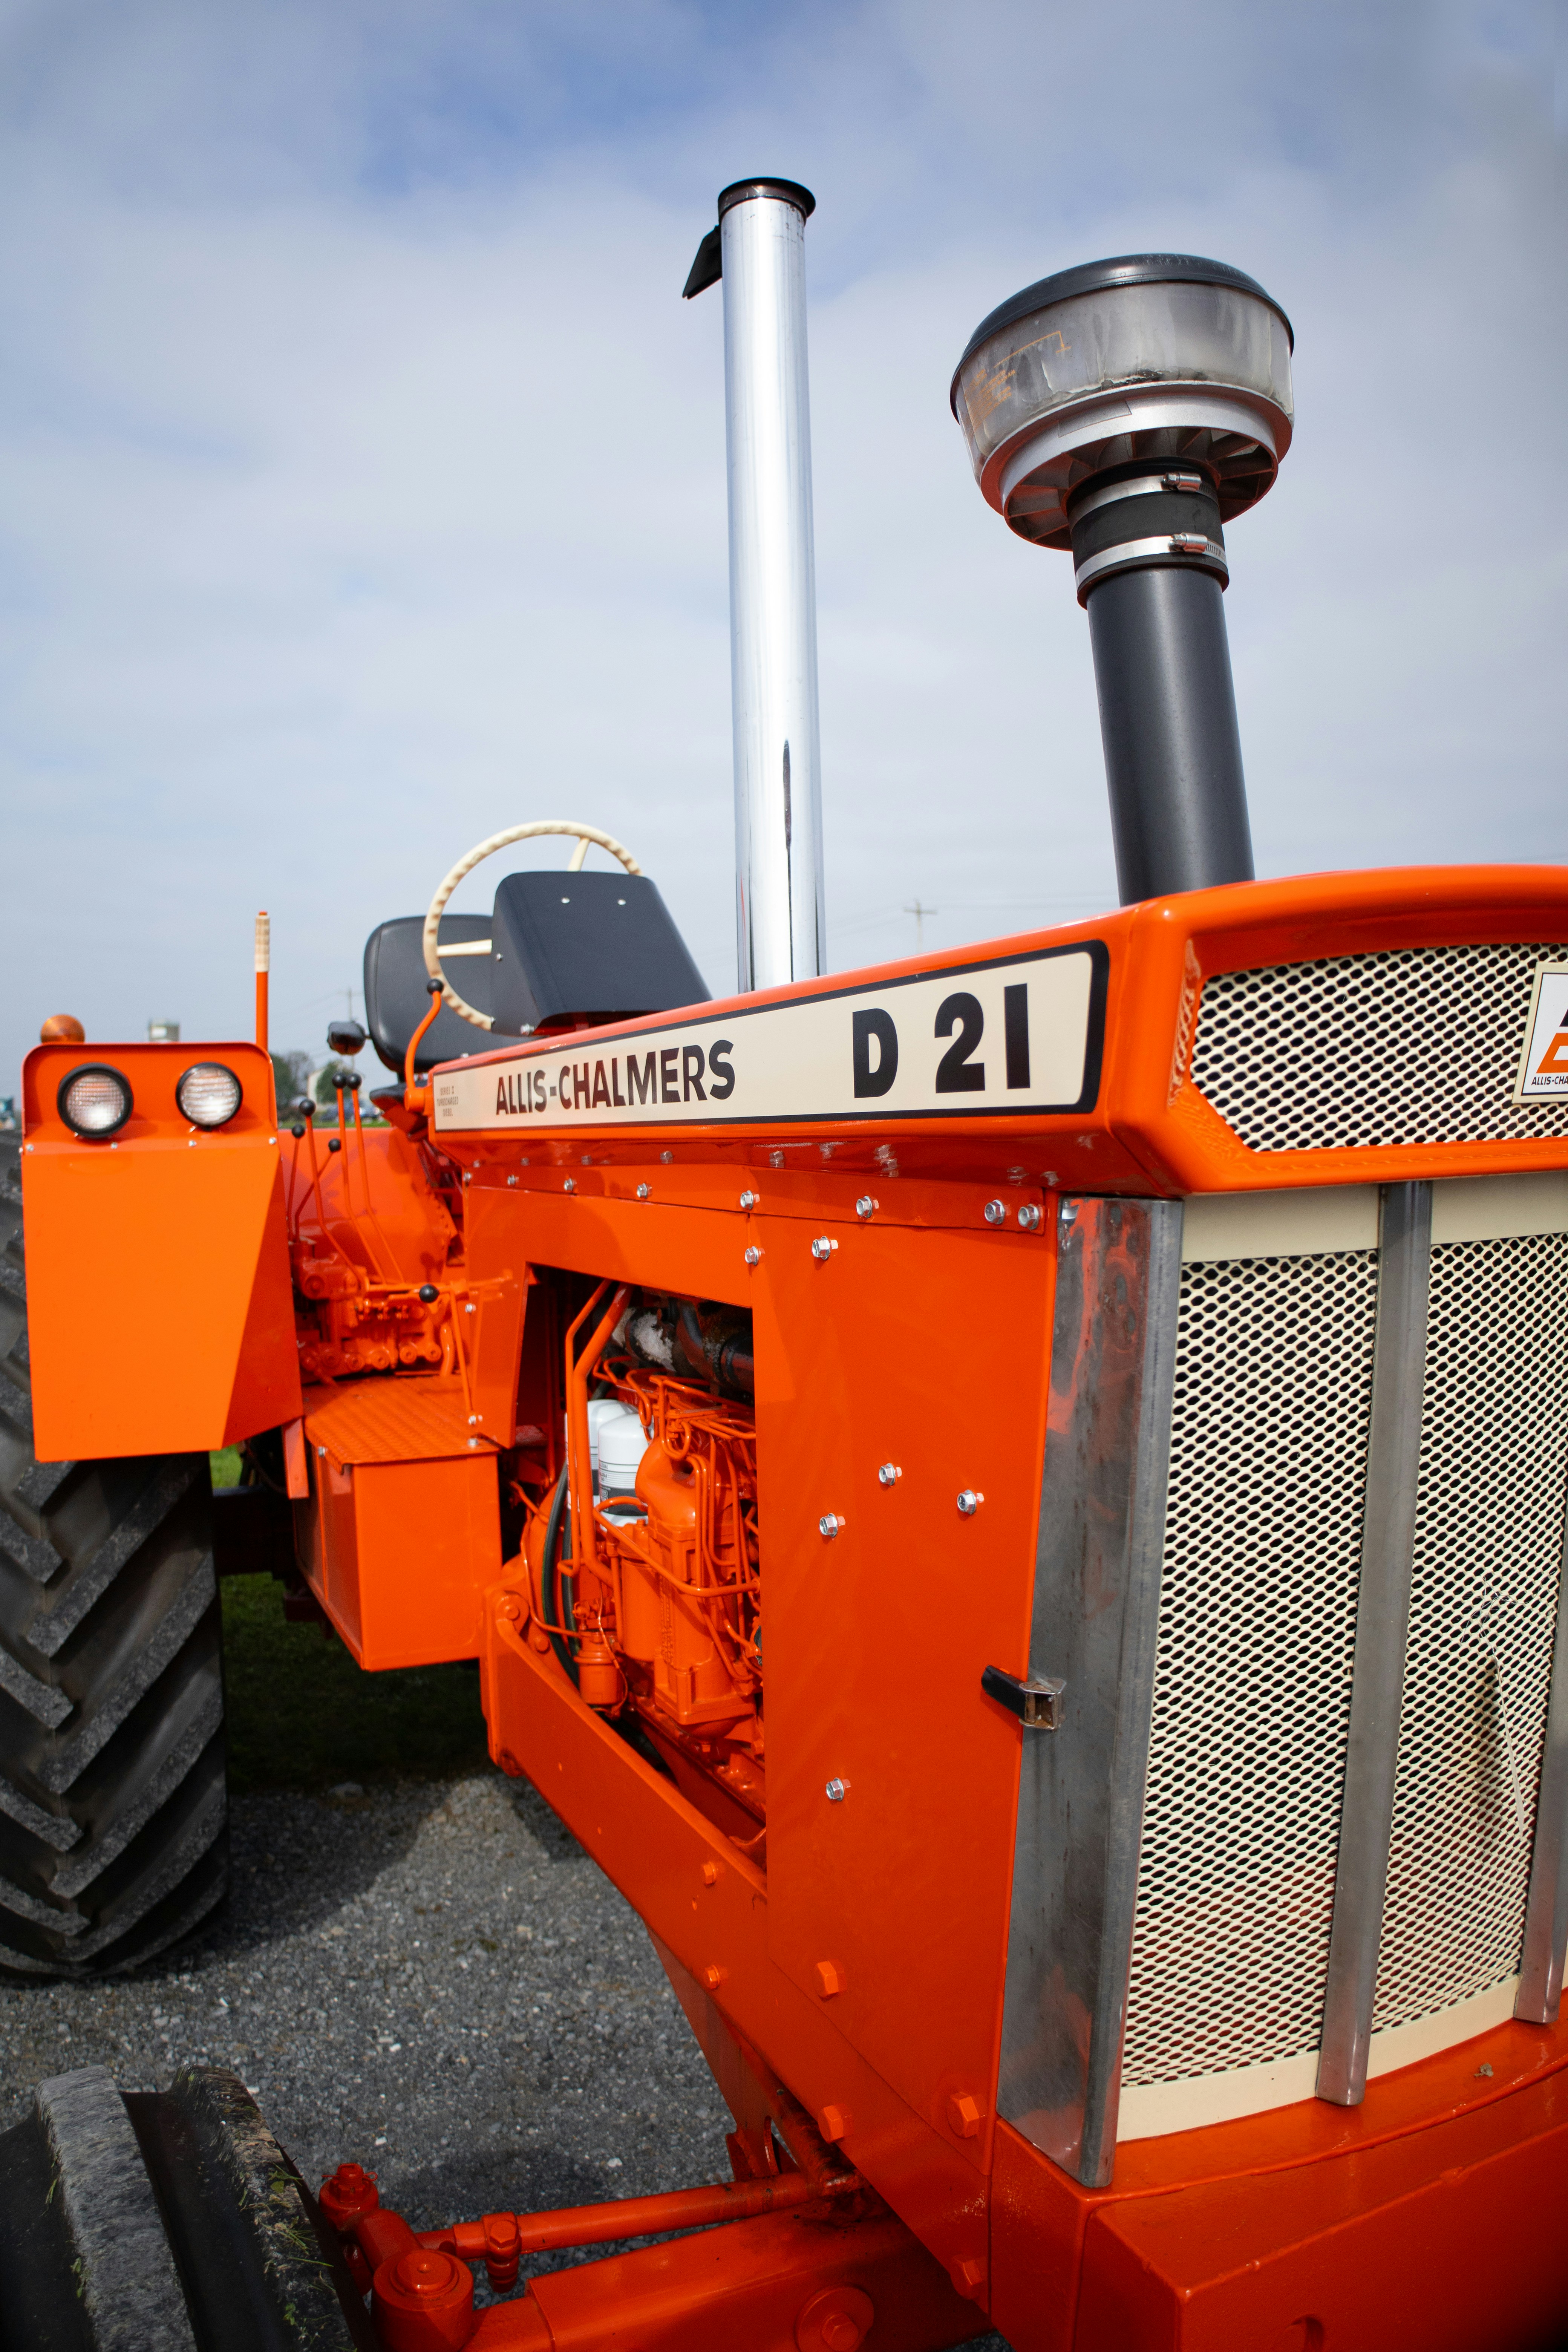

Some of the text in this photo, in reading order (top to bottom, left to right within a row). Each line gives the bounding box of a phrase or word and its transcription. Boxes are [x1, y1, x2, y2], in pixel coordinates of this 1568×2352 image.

[852, 983, 1031, 1099] D 21
[496, 1039, 735, 1116] ALLIS-CHALMERS
[440, 1087, 450, 1095] SERIES
[437, 1096, 458, 1106] TURBOCHARGED
[443, 1108, 453, 1116] DIESEL
